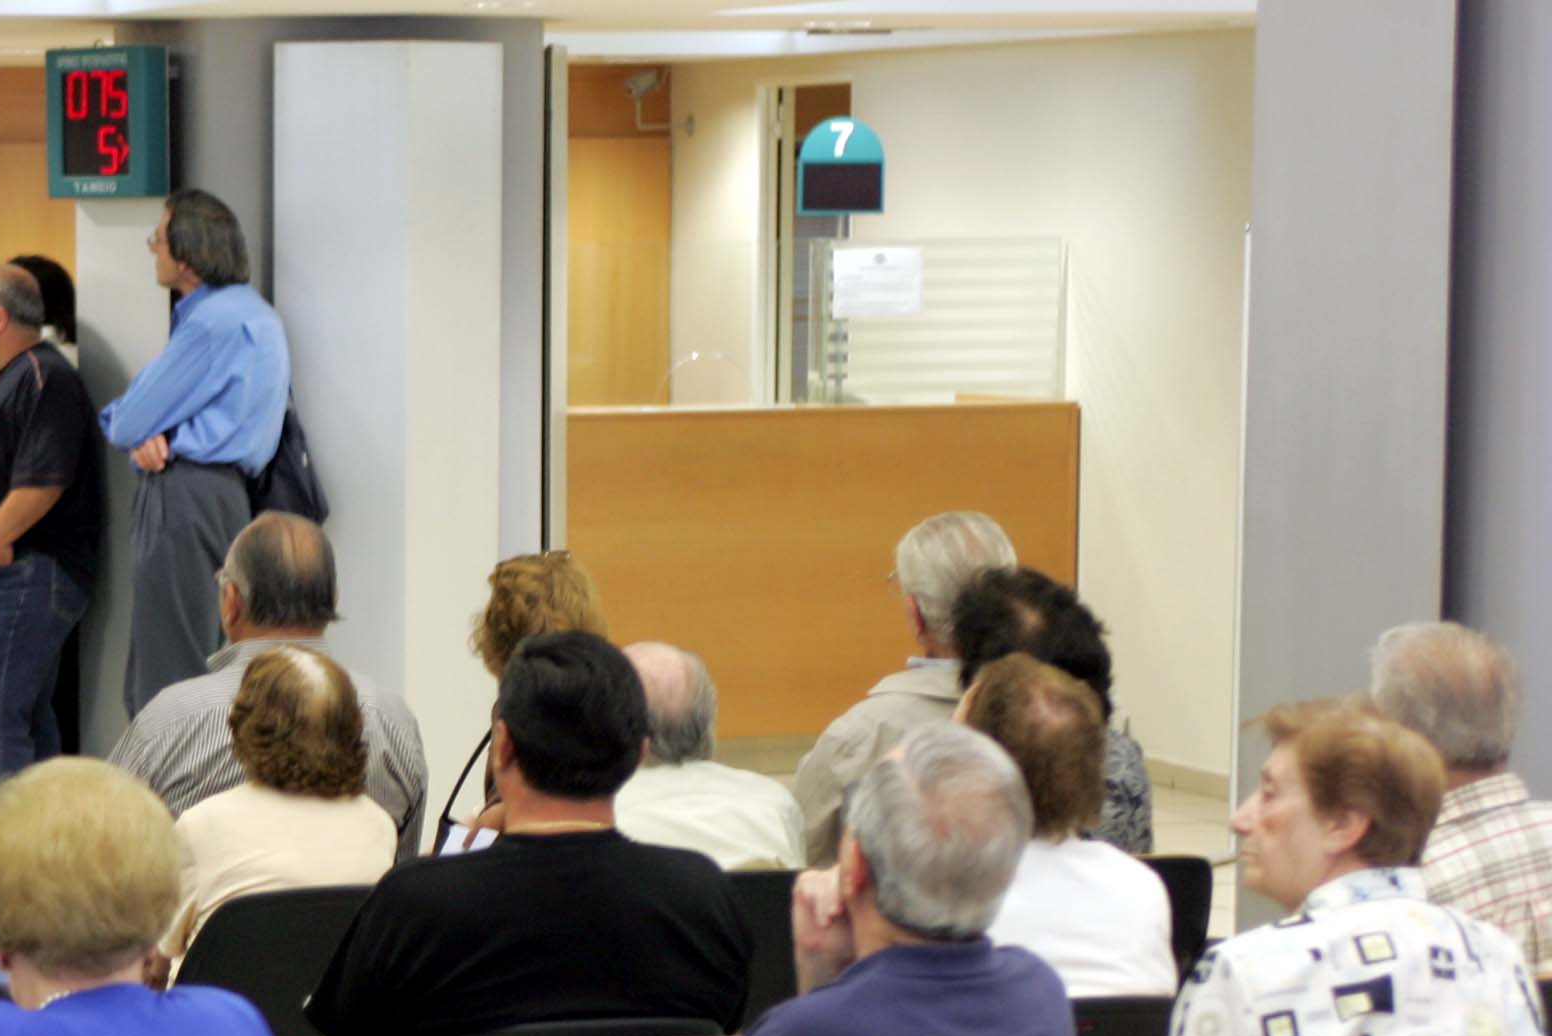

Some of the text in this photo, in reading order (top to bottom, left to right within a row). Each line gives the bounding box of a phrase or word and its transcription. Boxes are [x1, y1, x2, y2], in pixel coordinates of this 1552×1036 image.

[66, 70, 129, 119] 075
[97, 124, 118, 175] 5
[830, 121, 855, 158] 7
